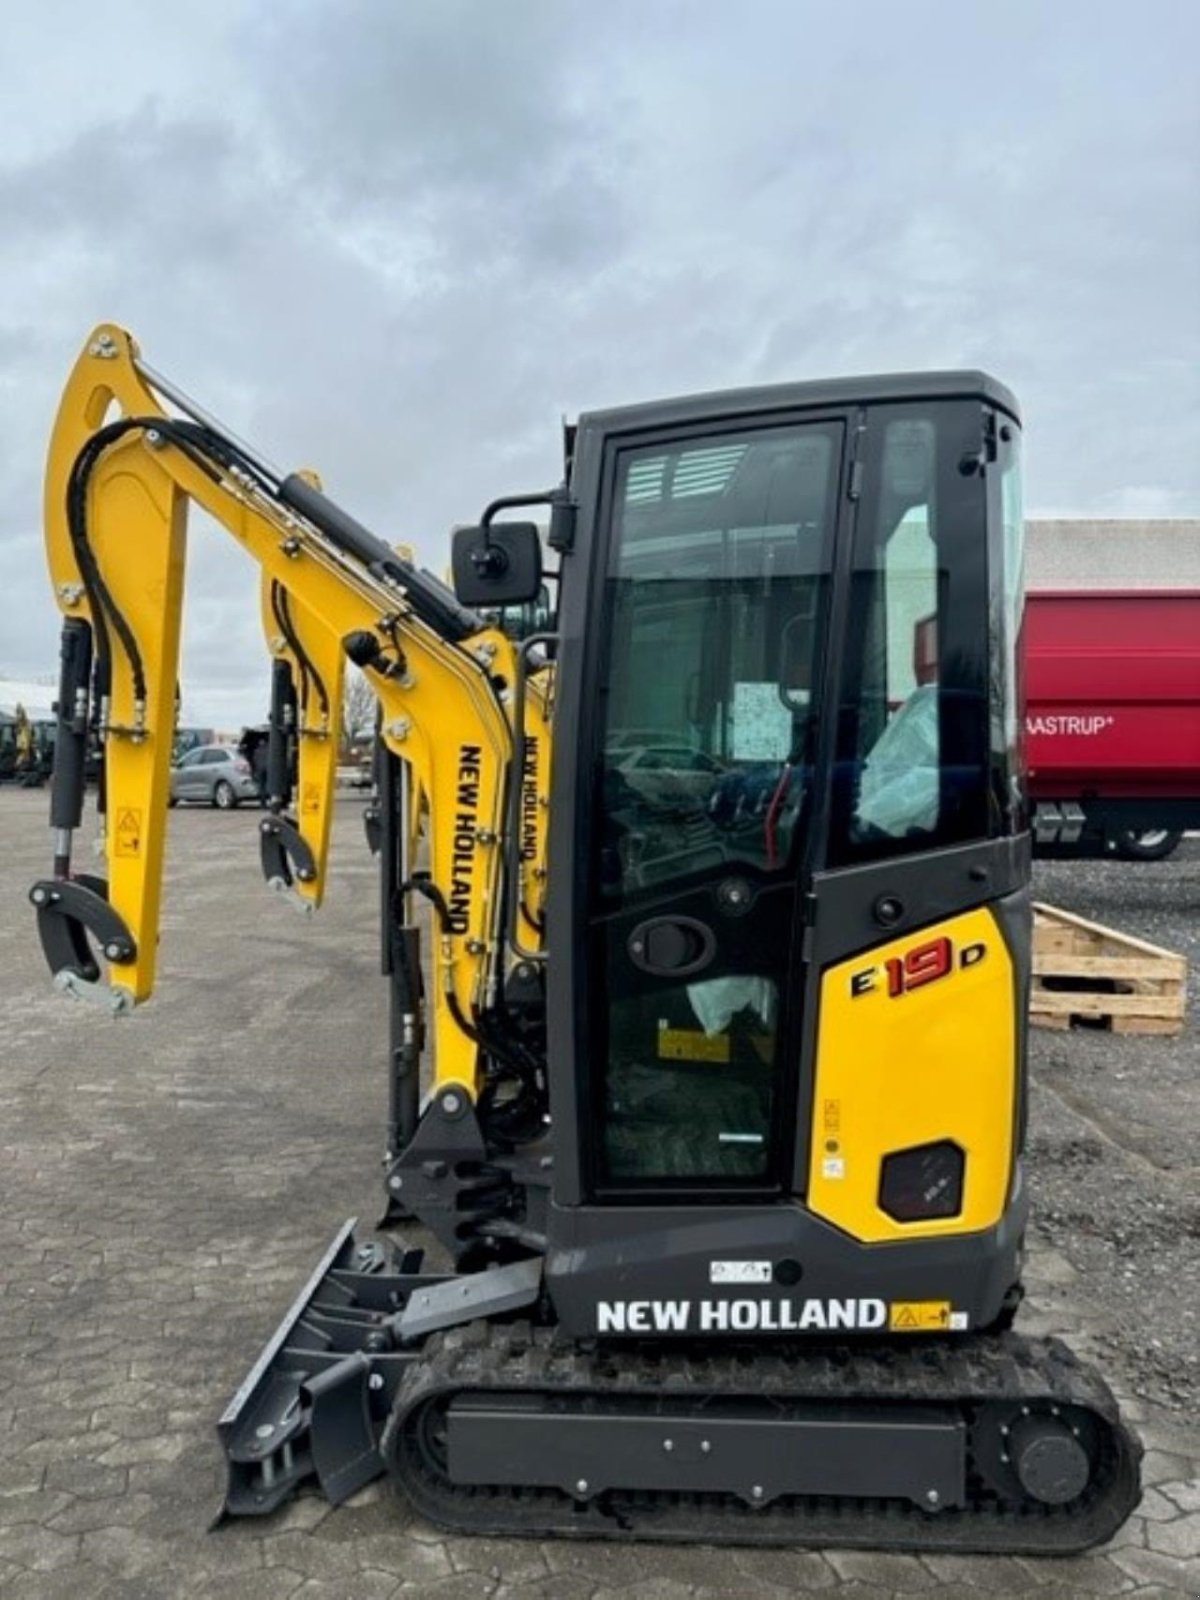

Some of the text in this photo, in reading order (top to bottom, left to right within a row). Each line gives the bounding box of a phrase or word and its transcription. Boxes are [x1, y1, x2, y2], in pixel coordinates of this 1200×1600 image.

[448, 745, 481, 935] NEW HOLLAND
[523, 736, 538, 861] NEW HOLLAND
[597, 1298, 886, 1332] NEW HOLLAND
